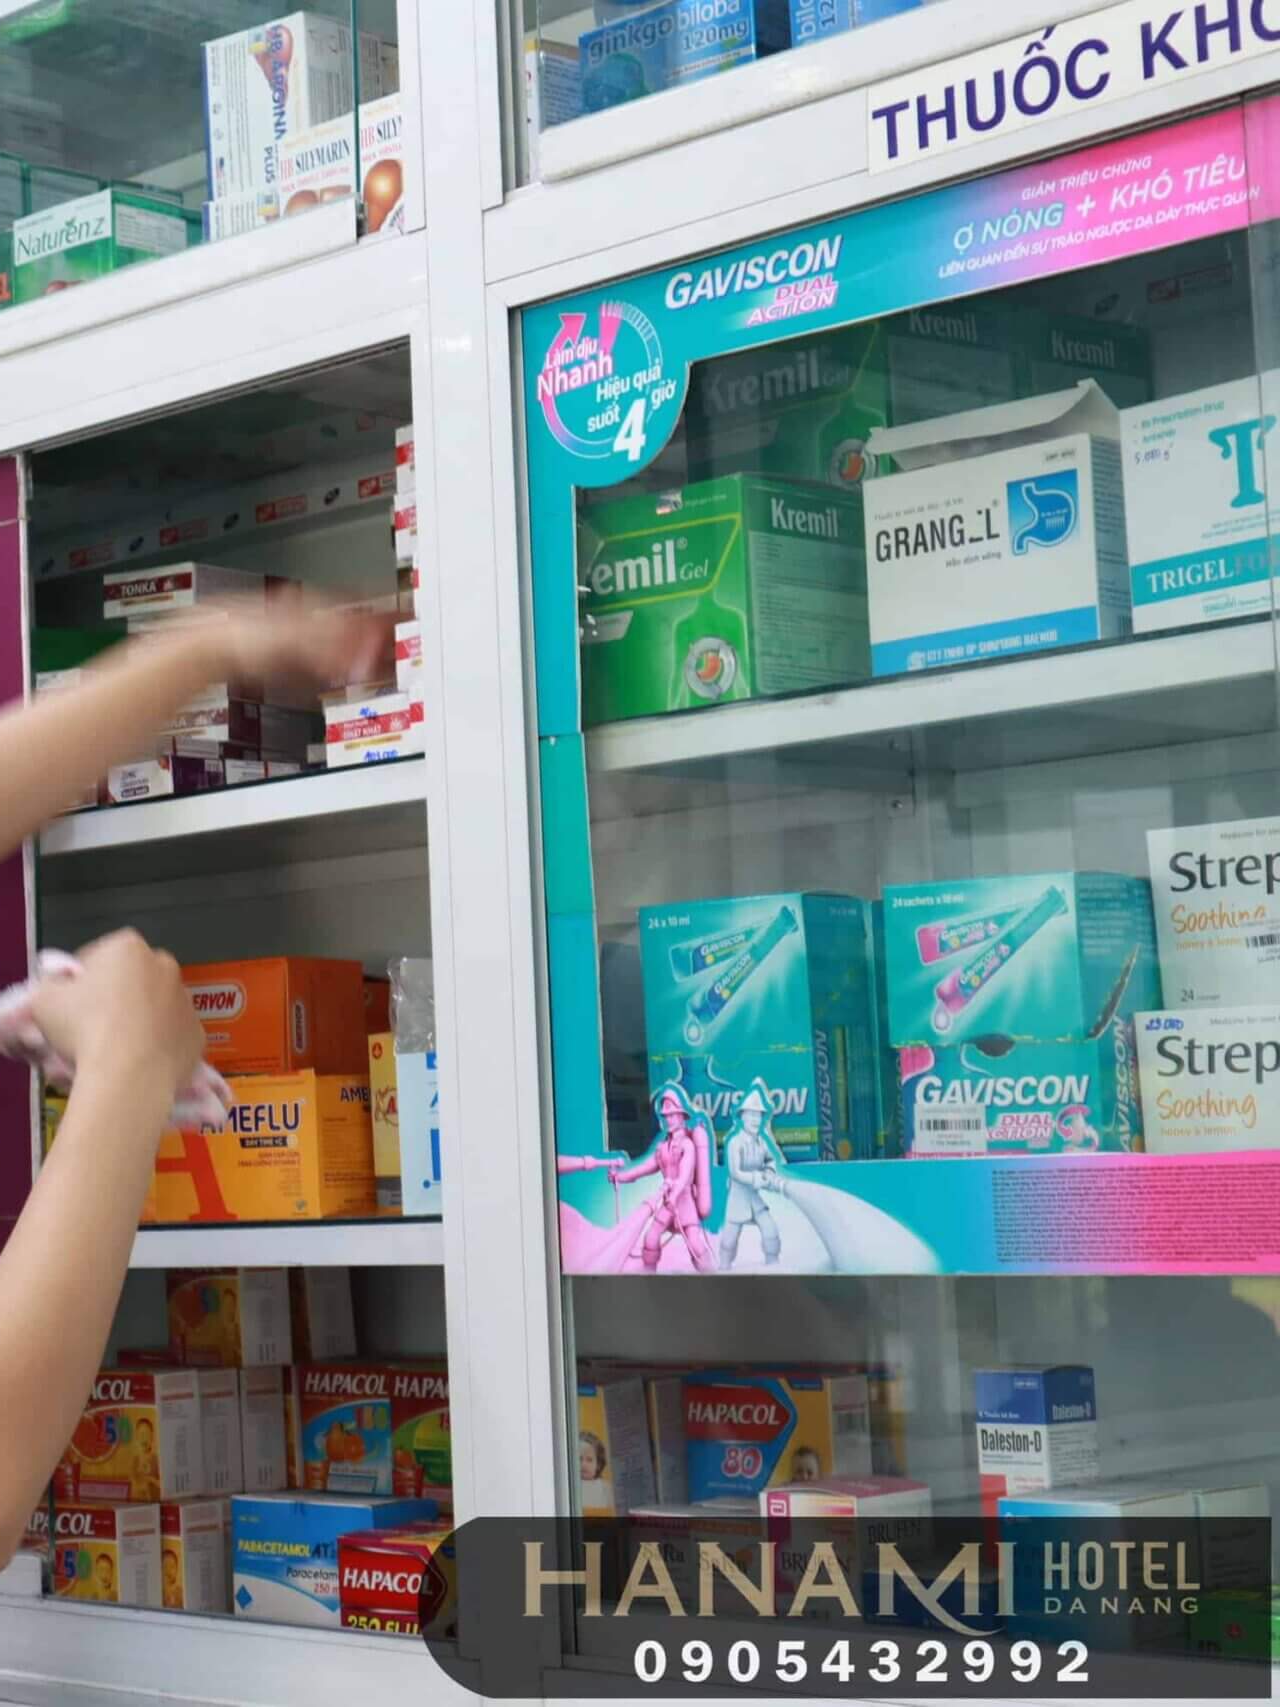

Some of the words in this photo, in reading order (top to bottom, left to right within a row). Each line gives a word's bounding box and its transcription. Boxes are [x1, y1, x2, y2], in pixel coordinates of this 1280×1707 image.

[589, 12, 673, 64] ginkgo
[683, 18, 749, 51] 120mg
[871, 24, 1113, 160] THUỐC
[1108, 168, 1175, 213] KHÓ
[664, 234, 842, 311] GAVISCON
[774, 273, 838, 302] DUAL
[744, 283, 839, 328] ACTION
[910, 311, 978, 343] Kremil
[1051, 329, 1117, 369] Kremil
[537, 350, 613, 401] Nhanh
[702, 350, 819, 415] Kremil
[613, 397, 646, 462] 4
[771, 497, 839, 538] Kremil
[592, 538, 677, 596] emil
[680, 559, 711, 582] Gel
[121, 581, 158, 597] TONKA
[192, 991, 236, 1012] ERVON
[1181, 988, 1195, 1002] 24
[1157, 1036, 1280, 1084] Strep
[915, 1075, 1089, 1107] GAVISCON
[1115, 1014, 1133, 1150] AVISCON
[200, 1102, 300, 1136] MEFLU
[1000, 1112, 1054, 1128] DUAL
[1156, 1087, 1257, 1129] Soothing
[91, 1378, 135, 1400] ACOL
[305, 1372, 389, 1395] HAPACOL
[688, 1402, 780, 1425] HAPACOL
[980, 1429, 1042, 1453] Daleston-D
[721, 1446, 763, 1479] 80
[239, 1538, 311, 1558] PARACETAMOL
[286, 1566, 338, 1581] Paracetam
[343, 1567, 433, 1595] HAPACOL
